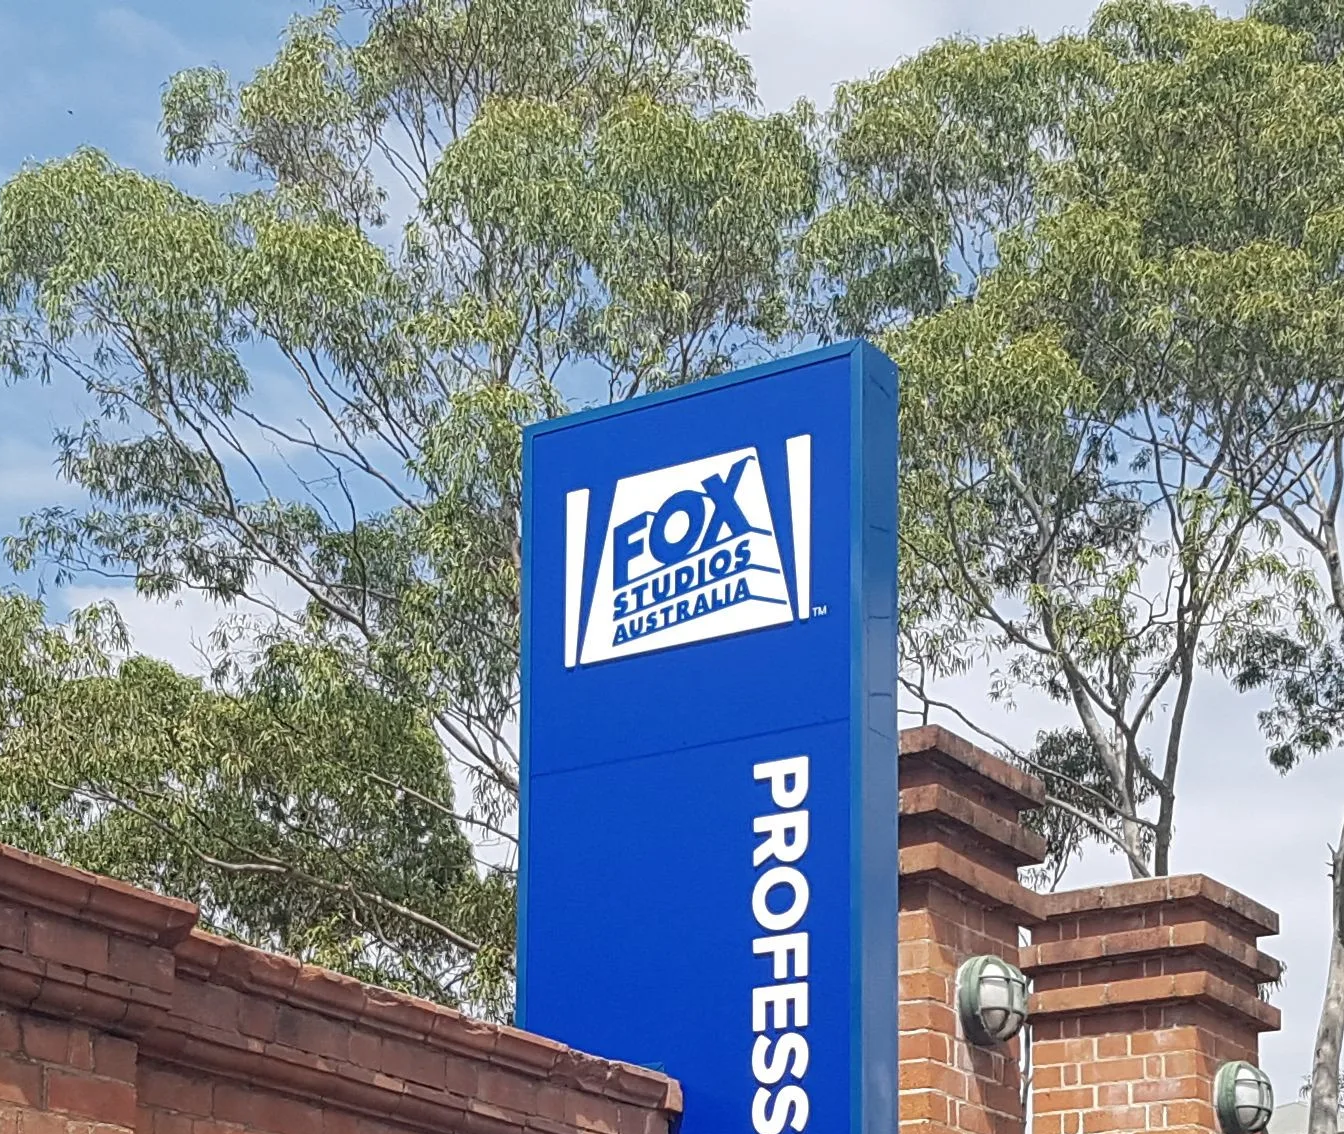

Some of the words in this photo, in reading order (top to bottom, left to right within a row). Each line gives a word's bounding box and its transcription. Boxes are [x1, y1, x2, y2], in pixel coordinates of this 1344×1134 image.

[613, 456, 754, 591] FOX
[612, 577, 751, 647] AUSTRALIA
[613, 539, 751, 622] STUDIOS
